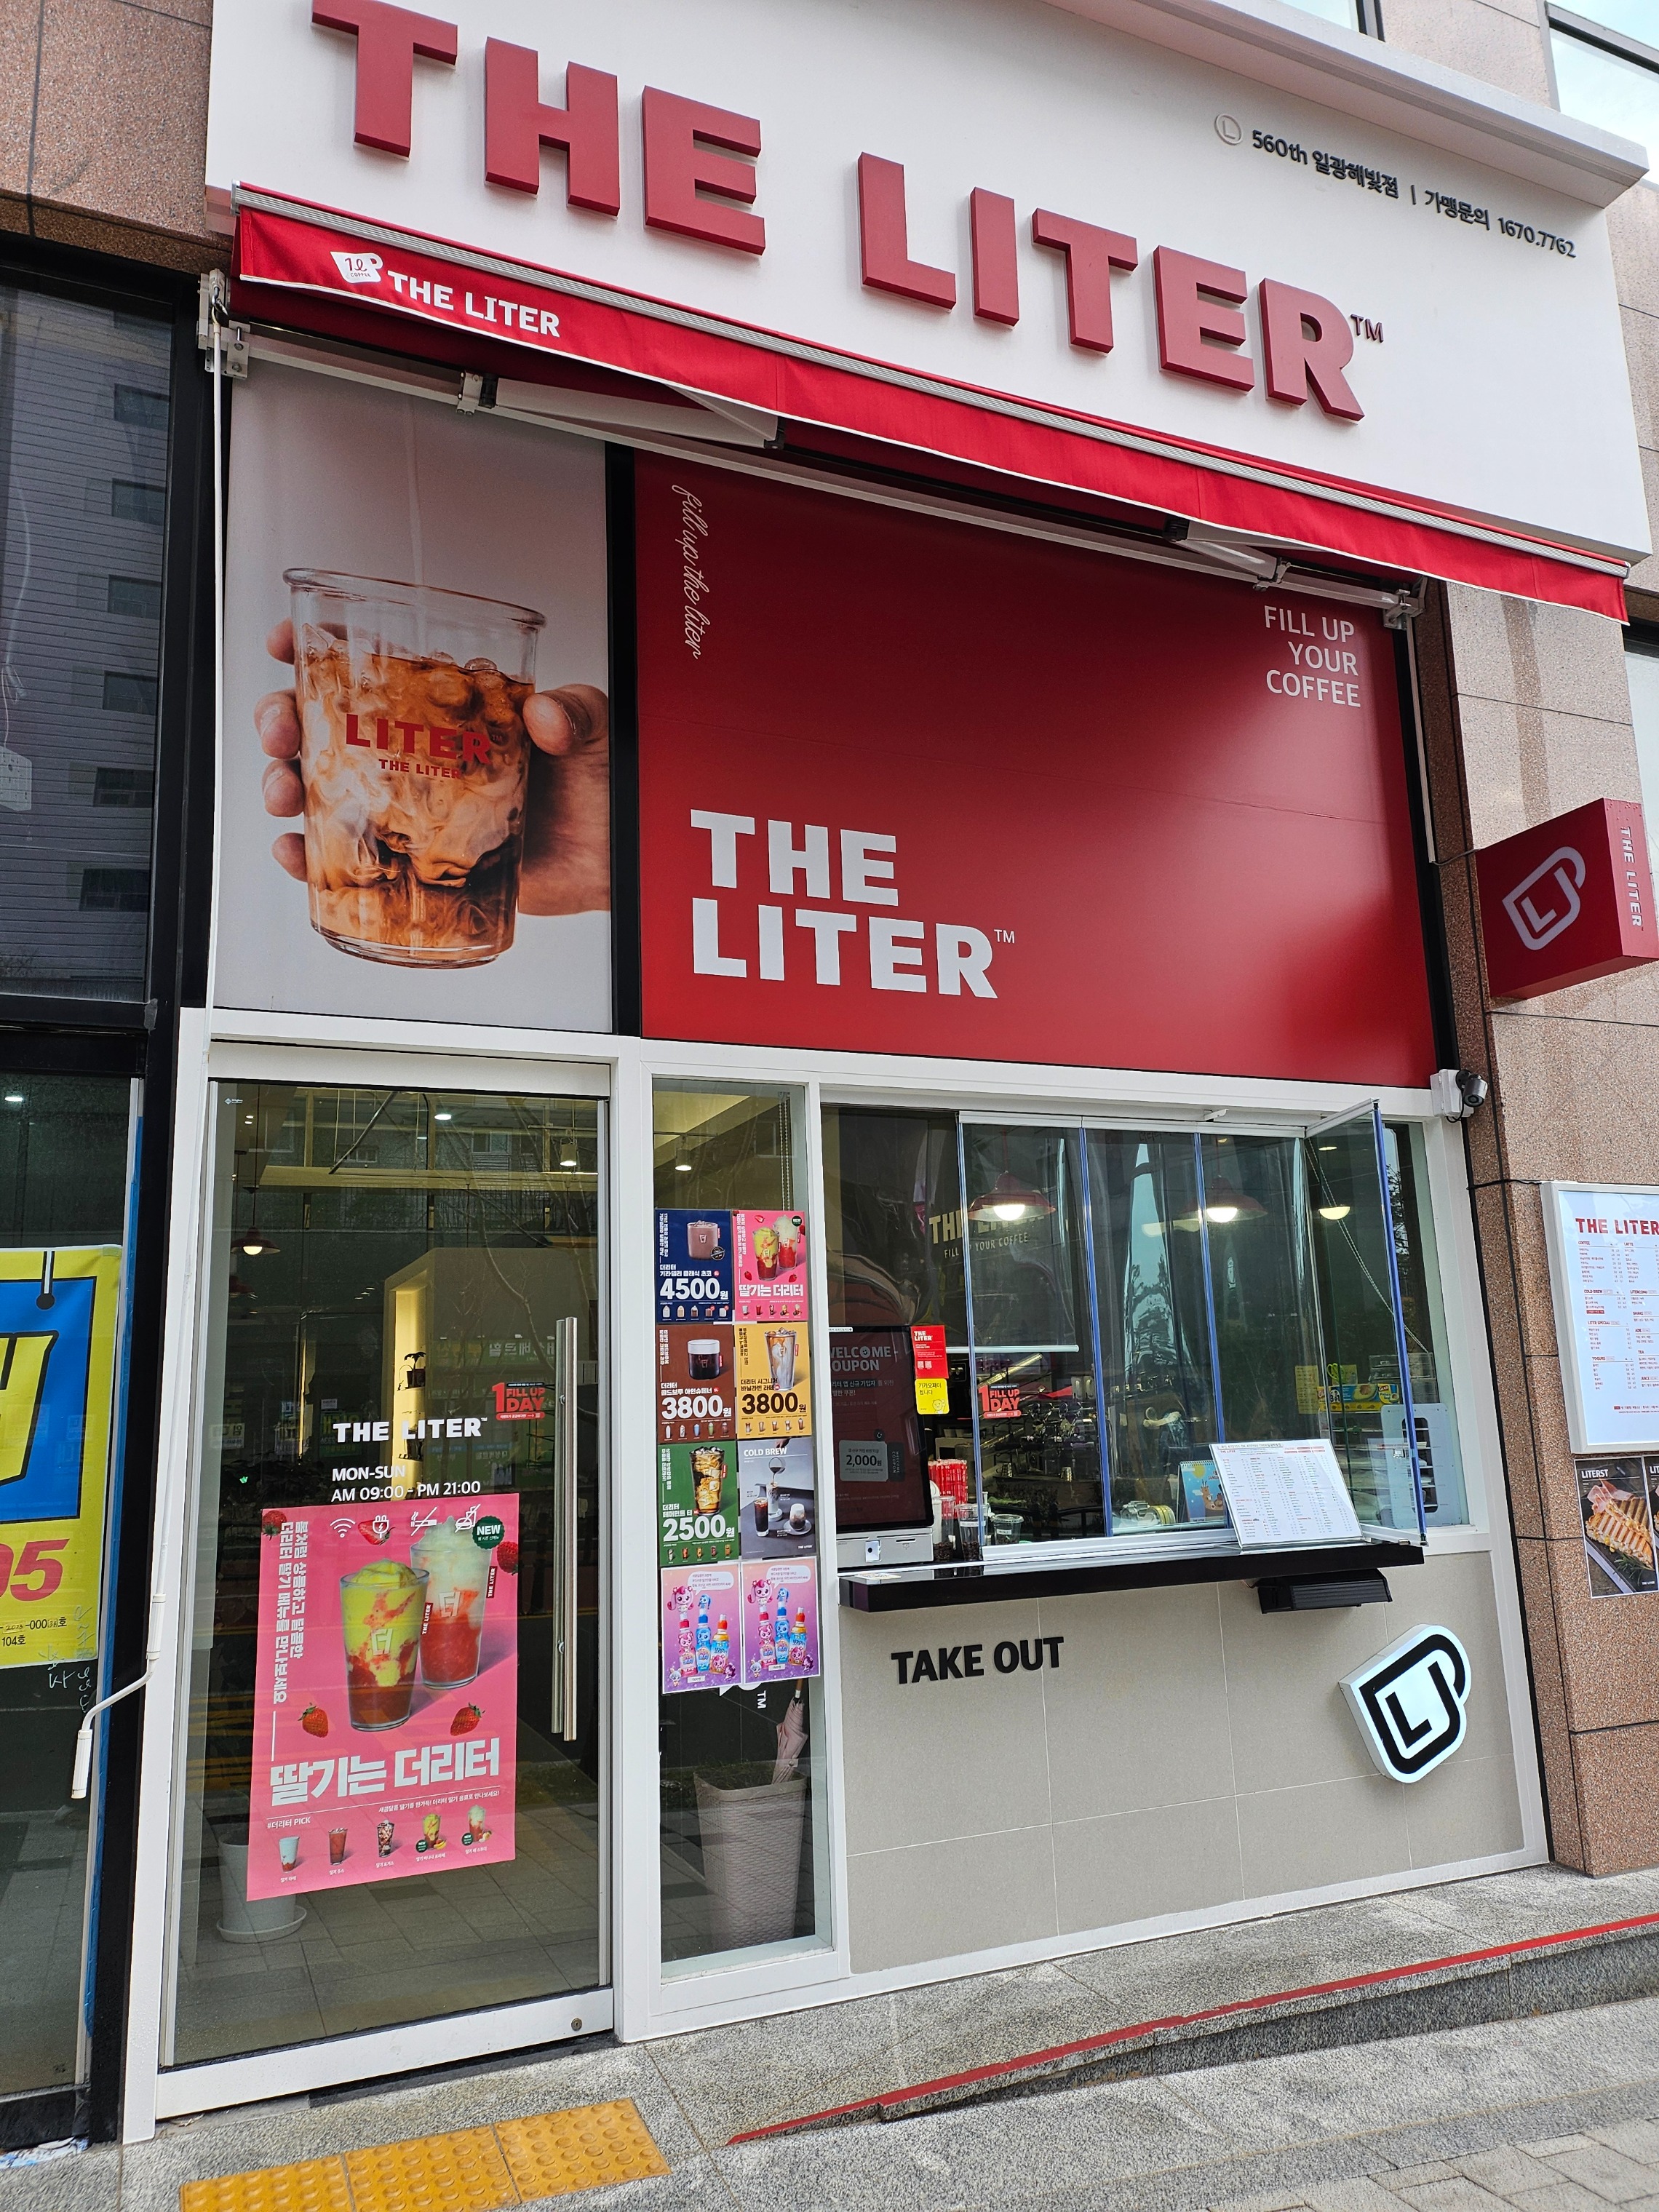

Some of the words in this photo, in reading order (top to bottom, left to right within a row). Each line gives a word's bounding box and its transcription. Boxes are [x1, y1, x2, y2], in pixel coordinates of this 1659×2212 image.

[312, 0, 765, 255] THE
[857, 151, 1365, 421] LITER
[1252, 129, 1308, 164] 560th
[1312, 149, 1399, 199] 일광해빛점
[1425, 190, 1490, 231] 가맹문의
[1497, 216, 1577, 258] 1670.7762
[387, 270, 454, 310] THE
[465, 292, 560, 338] LITER
[683, 565, 709, 605] the
[1264, 605, 1315, 637] FILL
[1322, 616, 1354, 642] UP
[1287, 641, 1358, 676] YOUR
[1266, 669, 1361, 707] COFFEE
[346, 714, 490, 764] LITER
[378, 758, 409, 772] THE
[416, 764, 461, 779] LITER
[691, 808, 899, 907] THE
[1620, 827, 1635, 864] THE
[1626, 870, 1642, 927] LITER
[692, 897, 998, 998] LITER
[1575, 1218, 1608, 1233] THE
[1615, 1220, 1659, 1235] LITER
[944, 1247, 959, 1258] FILL
[975, 1239, 995, 1251] YOUR
[998, 1232, 1028, 1246] COFFEE
[739, 1284, 771, 1297] 딸기는
[773, 1284, 803, 1297] 더리터
[831, 1359, 880, 1372] OUPON
[492, 1382, 505, 1412] 1
[506, 1388, 528, 1398] FILL
[530, 1388, 546, 1396] UP
[506, 1397, 545, 1412] DAY
[979, 1385, 990, 1412] 1
[1008, 1389, 1020, 1397] UP
[990, 1397, 1020, 1411] DAY
[333, 1421, 389, 1443] THE
[402, 1418, 481, 1440] LITER
[744, 1449, 764, 1457] COLD
[765, 1447, 787, 1455] BREW
[846, 1455, 882, 1467] 2,000원
[332, 1465, 406, 1481] MON-SUN
[1581, 1468, 1609, 1479] LITERST
[331, 1488, 355, 1502] AM
[359, 1485, 404, 1500] 09:00
[418, 1483, 439, 1497] PM
[443, 1481, 481, 1495] 21:00
[279, 1521, 293, 1559] 더리터
[294, 1521, 309, 1559] 봄처럼
[477, 1524, 501, 1536] NEW
[278, 1562, 292, 1589] 딸기
[292, 1561, 307, 1615] 상큼하고
[276, 1592, 290, 1633] 메뉴를
[290, 1618, 304, 1659] 달콤한
[273, 1635, 289, 1705] 만나보세요
[891, 1644, 984, 1684] TAKE
[994, 1636, 1065, 1674] OUT
[270, 1755, 387, 1807] 딸기는
[394, 1737, 500, 1788] 더리터
[294, 1817, 311, 1826] PICK
